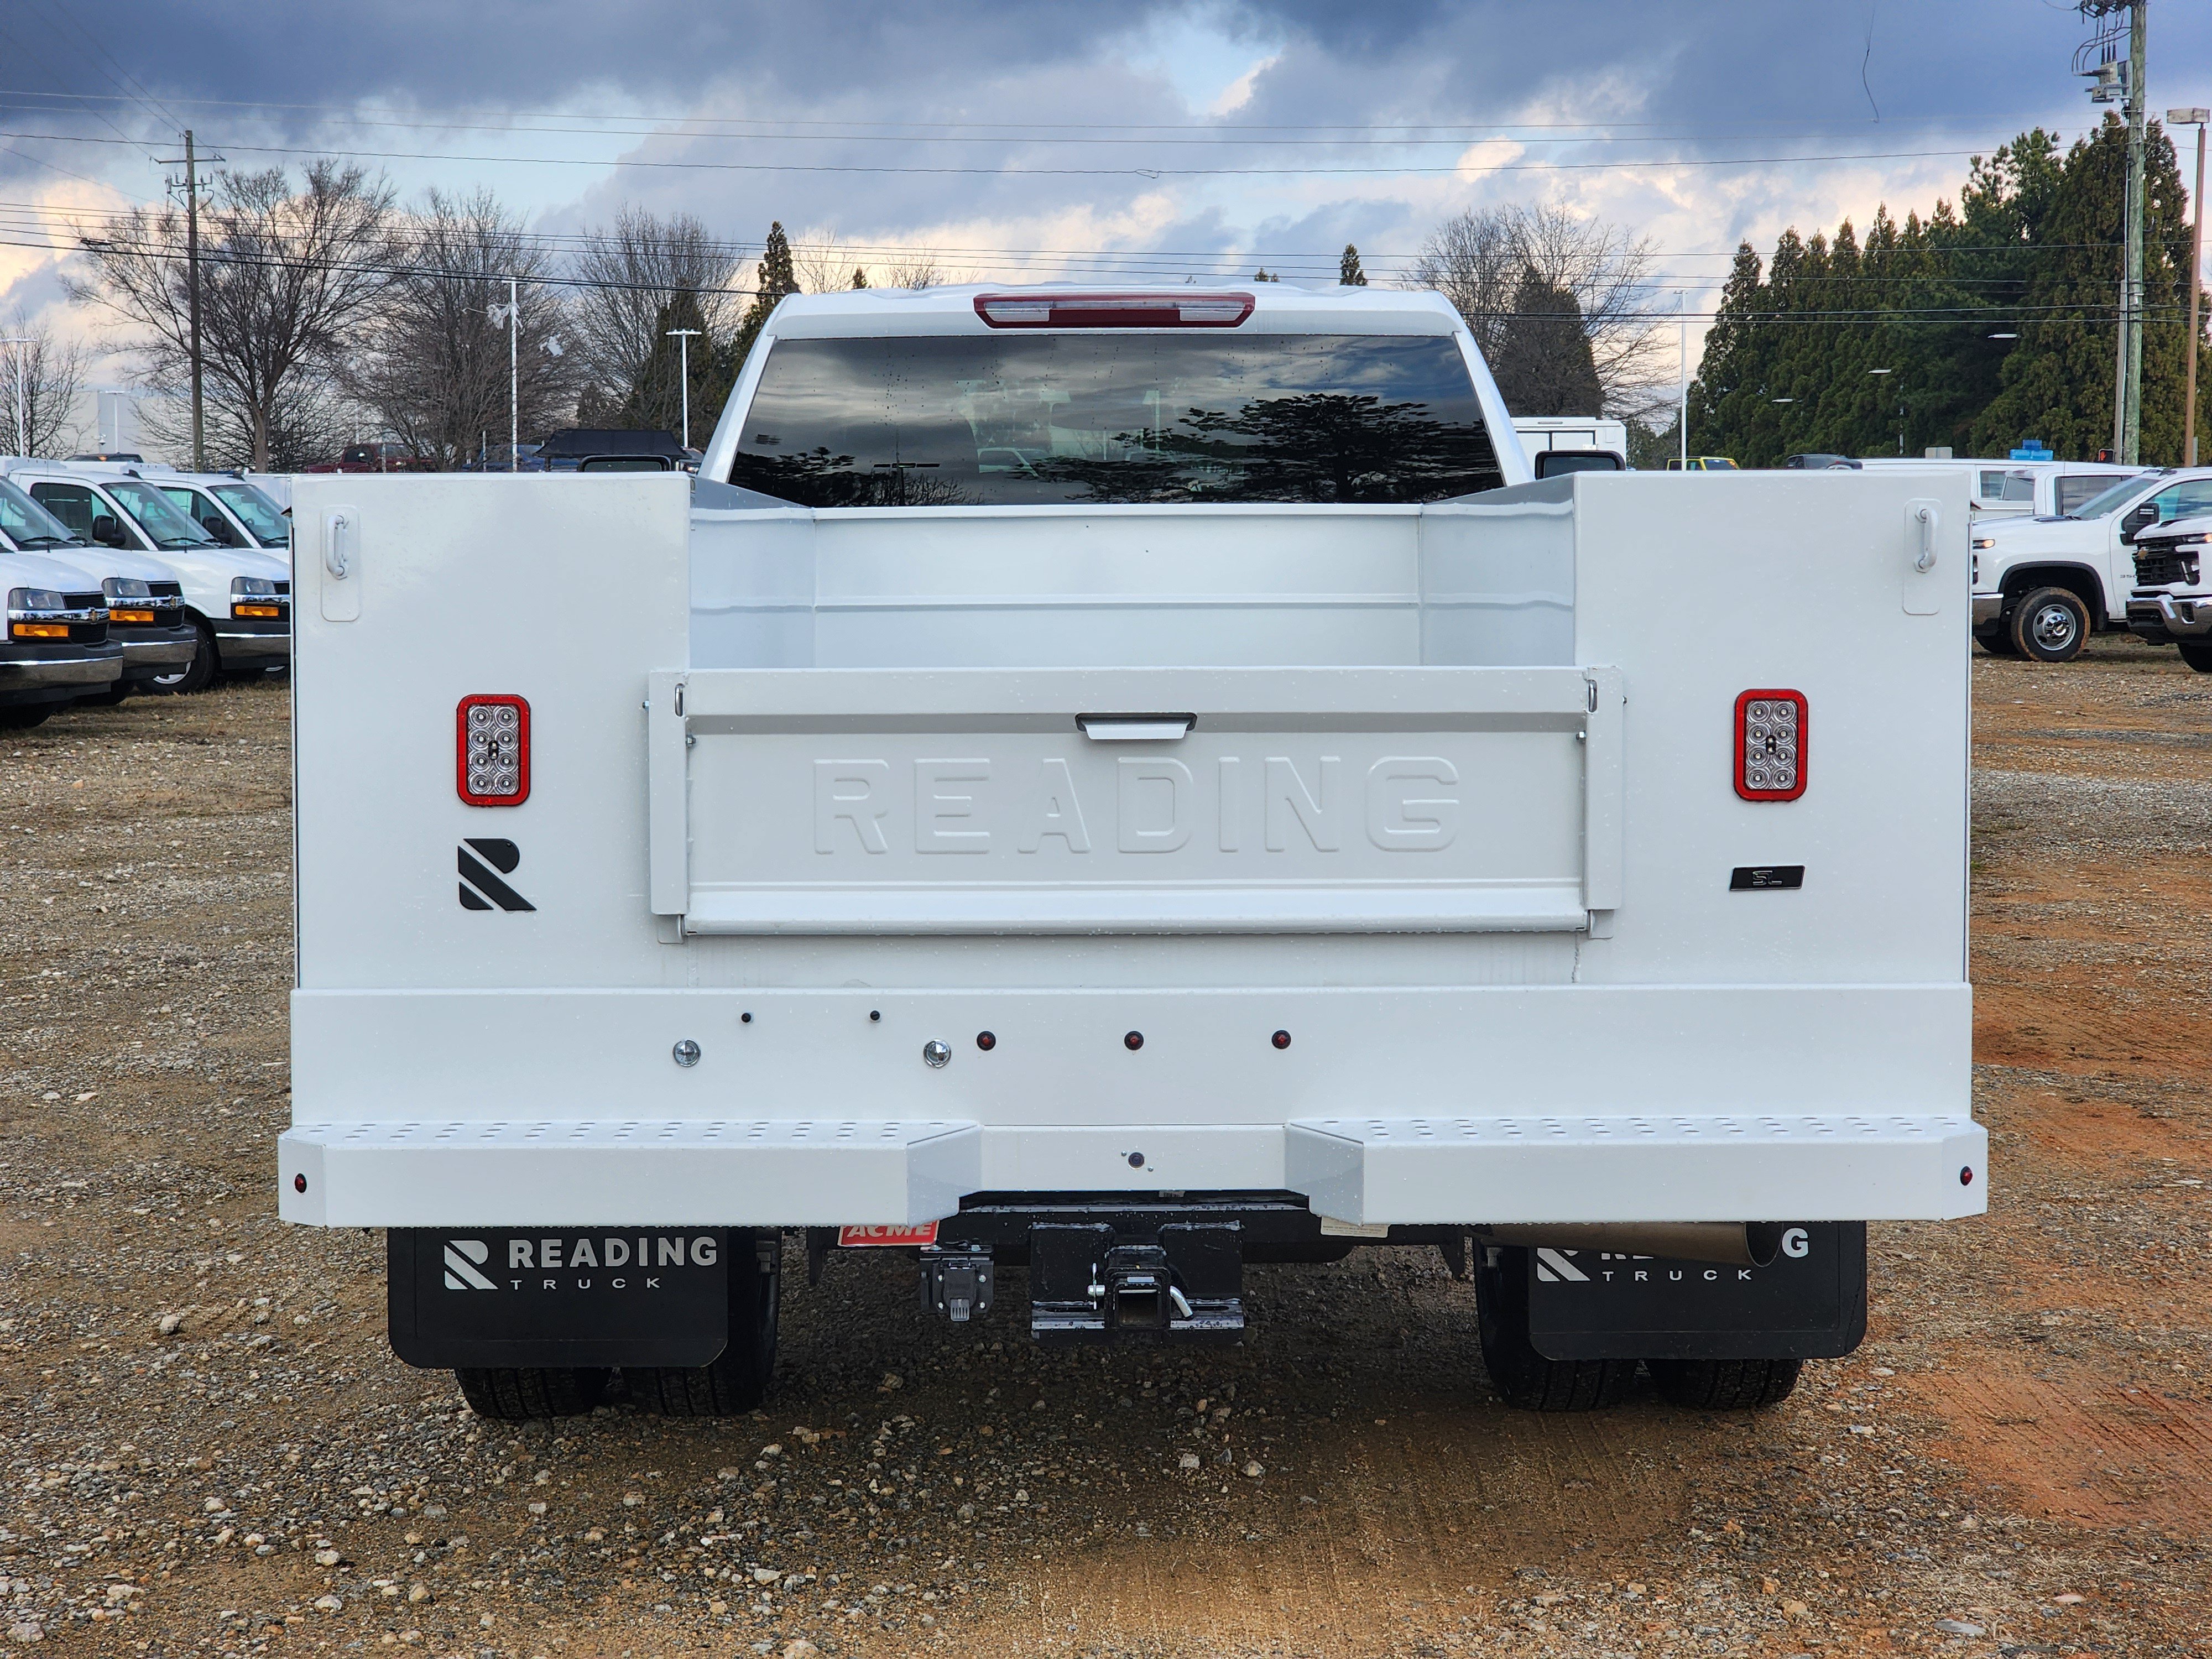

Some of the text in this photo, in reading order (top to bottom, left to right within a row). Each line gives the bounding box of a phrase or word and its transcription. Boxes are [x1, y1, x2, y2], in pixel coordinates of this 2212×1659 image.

[813, 756, 1460, 855] READING
[509, 1237, 717, 1268] READING
[510, 1277, 660, 1290] TRUCK
[1602, 1269, 1752, 1281] TRUCK
